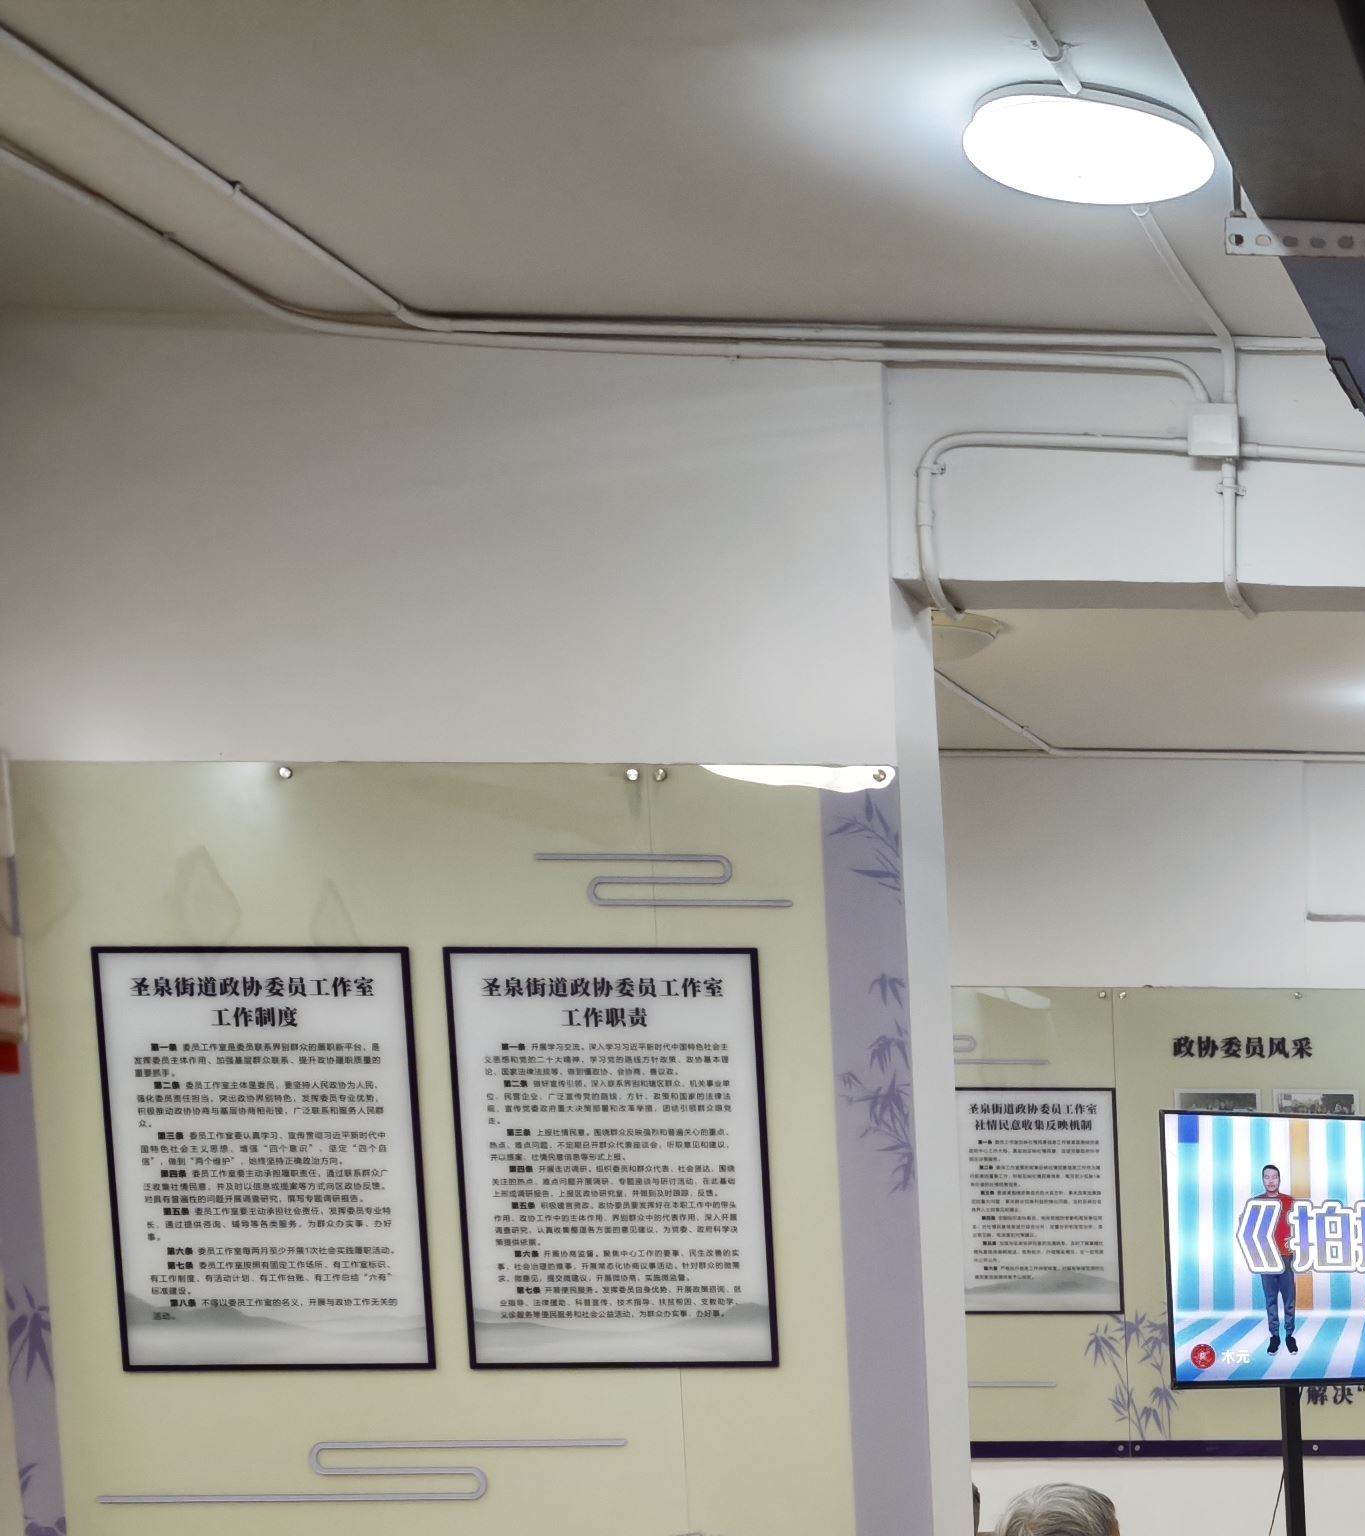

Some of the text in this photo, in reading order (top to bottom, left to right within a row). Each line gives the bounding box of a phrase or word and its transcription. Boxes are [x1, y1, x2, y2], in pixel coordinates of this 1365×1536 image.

[130, 976, 374, 998] 圣泉街道政协委员工作室
[481, 976, 723, 998] 圣泉街道政协委员工作室
[211, 1007, 298, 1028] 工作制度
[562, 1007, 648, 1028] 工作职责
[1172, 1036, 1313, 1059] 政协委员风采
[969, 1103, 1098, 1116] 圣泉街道政协委员工作室
[975, 1120, 1092, 1131] 社情民意收集反映机制
[1221, 1349, 1250, 1364] 木元
